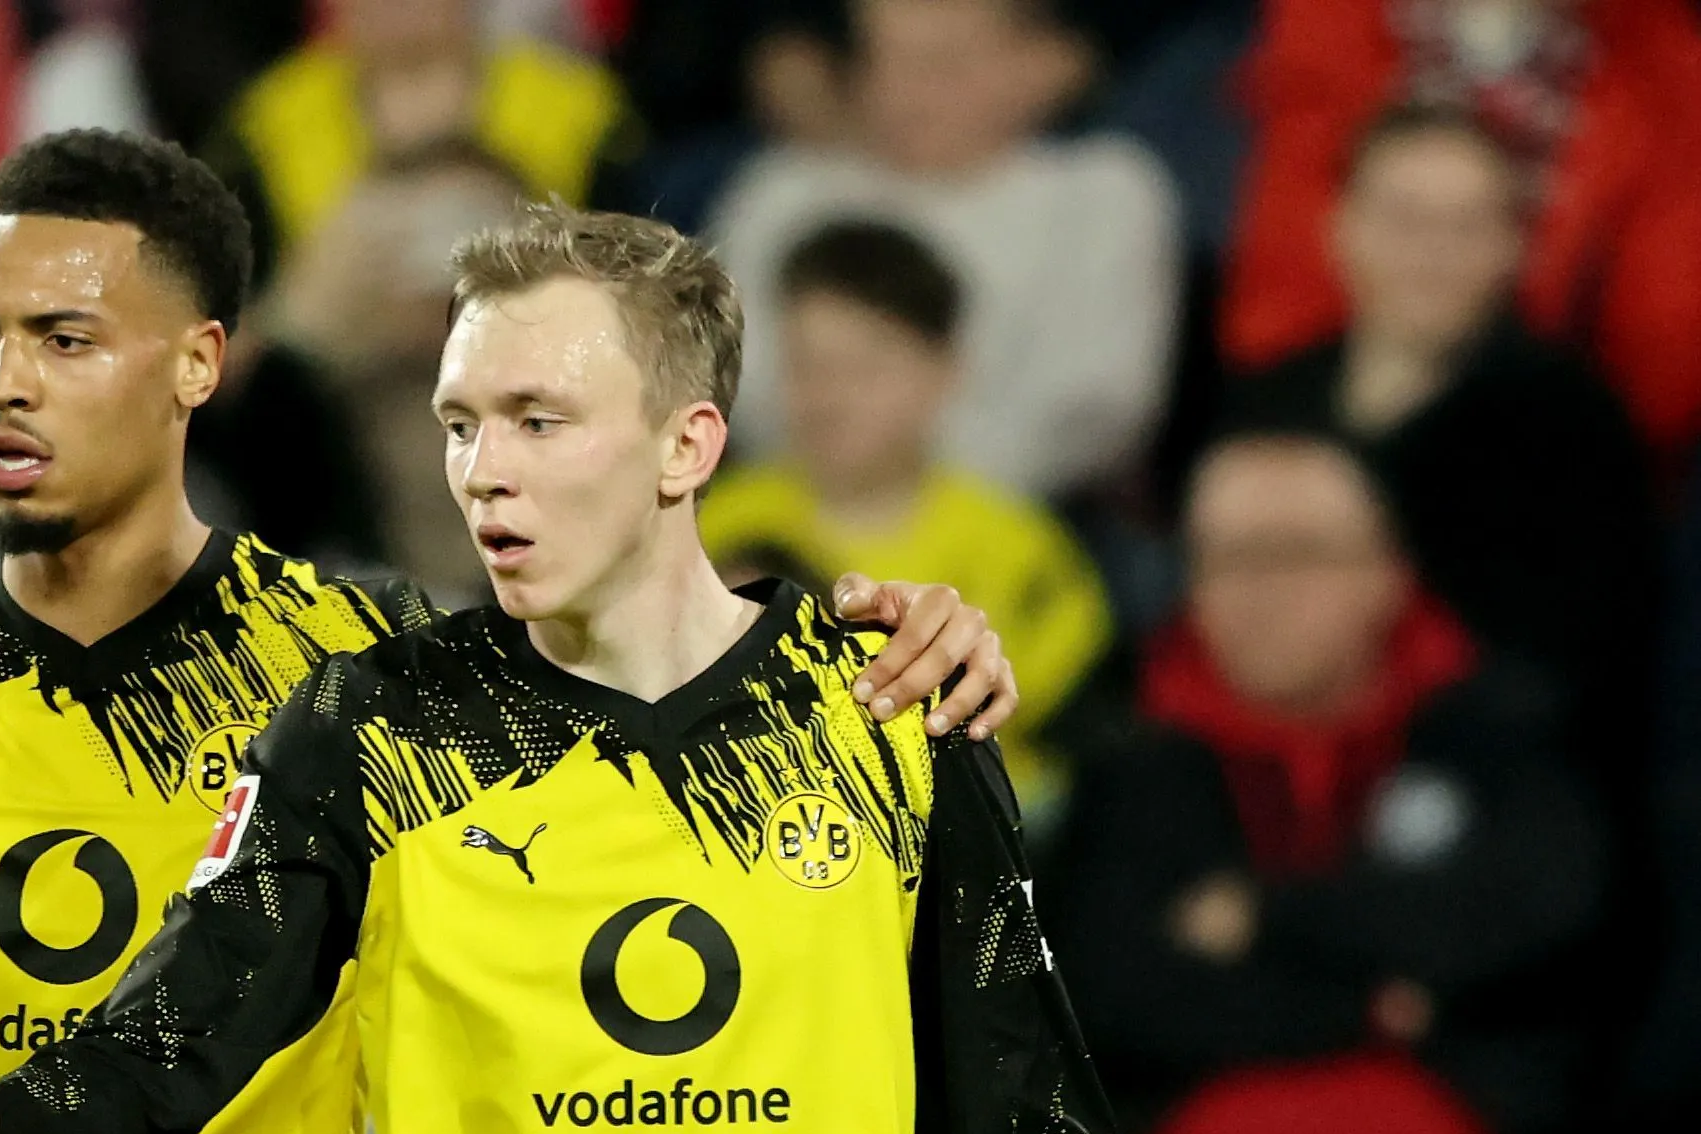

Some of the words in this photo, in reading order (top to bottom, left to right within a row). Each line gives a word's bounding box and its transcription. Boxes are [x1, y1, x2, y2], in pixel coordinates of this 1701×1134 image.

[202, 733, 255, 790] BV
[779, 803, 851, 861] BVB
[533, 1077, 791, 1128] vodafone
